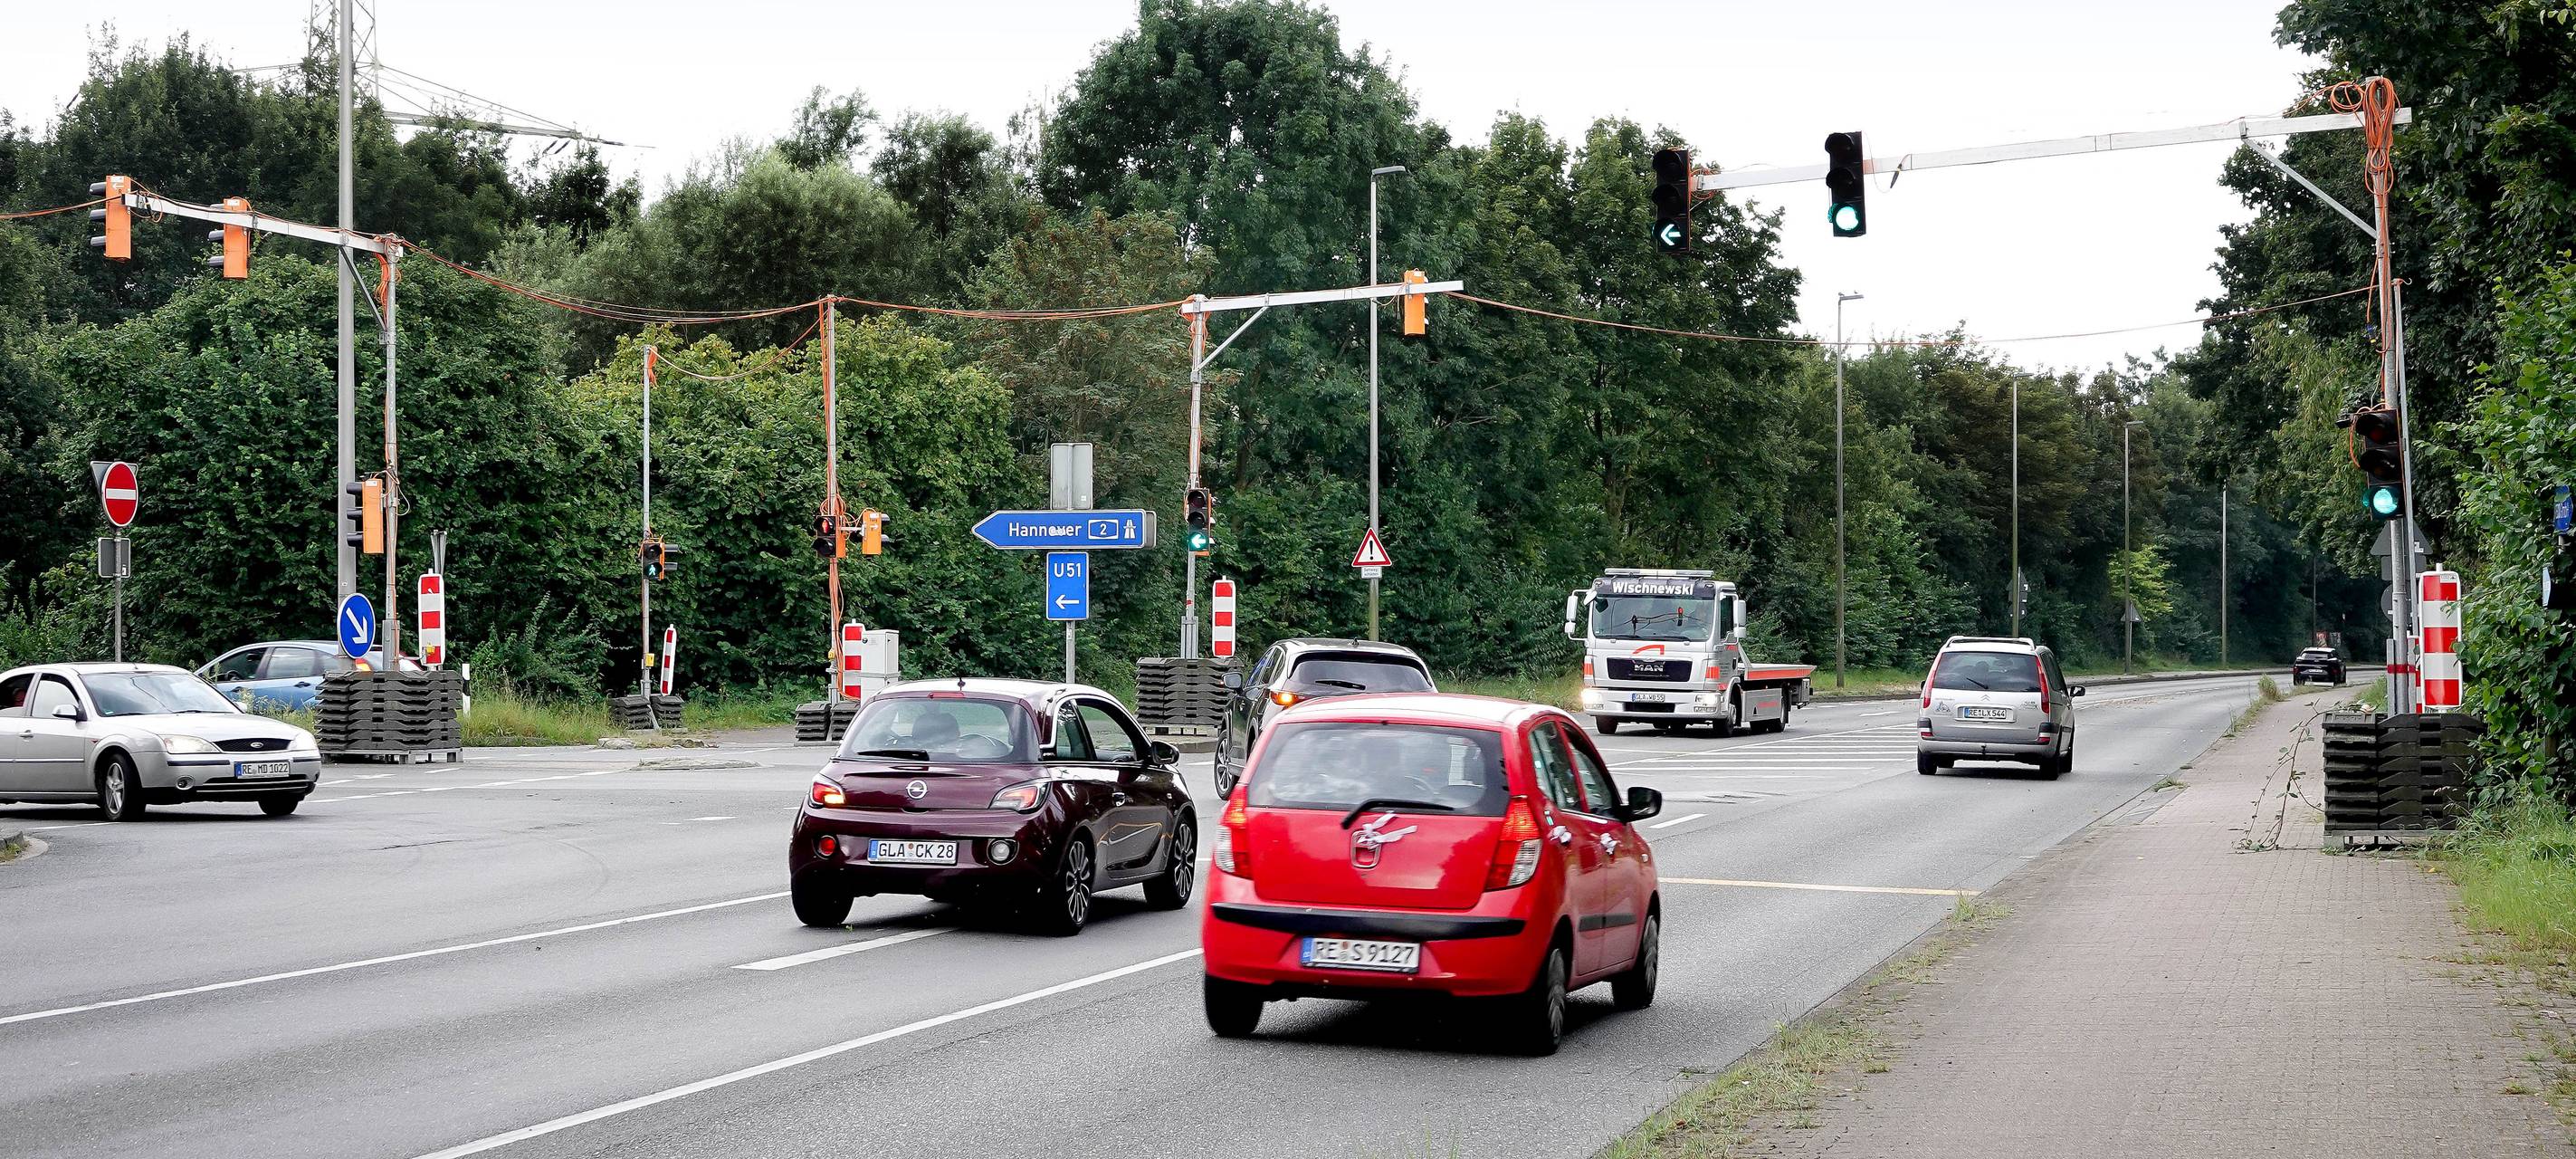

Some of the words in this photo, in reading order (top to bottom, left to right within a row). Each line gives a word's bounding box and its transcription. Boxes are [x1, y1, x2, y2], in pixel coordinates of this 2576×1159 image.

[1100, 523, 1107, 535] 2
[1612, 581, 1695, 595] Wischnewski
[1634, 664, 1664, 672] MAN
[242, 764, 253, 774] RE
[269, 763, 289, 773] 1022
[879, 843, 905, 857] GLA
[916, 844, 934, 858] CK
[937, 845, 955, 858] 28
[1315, 941, 1337, 960] RE
[1352, 943, 1362, 962] S
[1368, 943, 1416, 964] 9127
